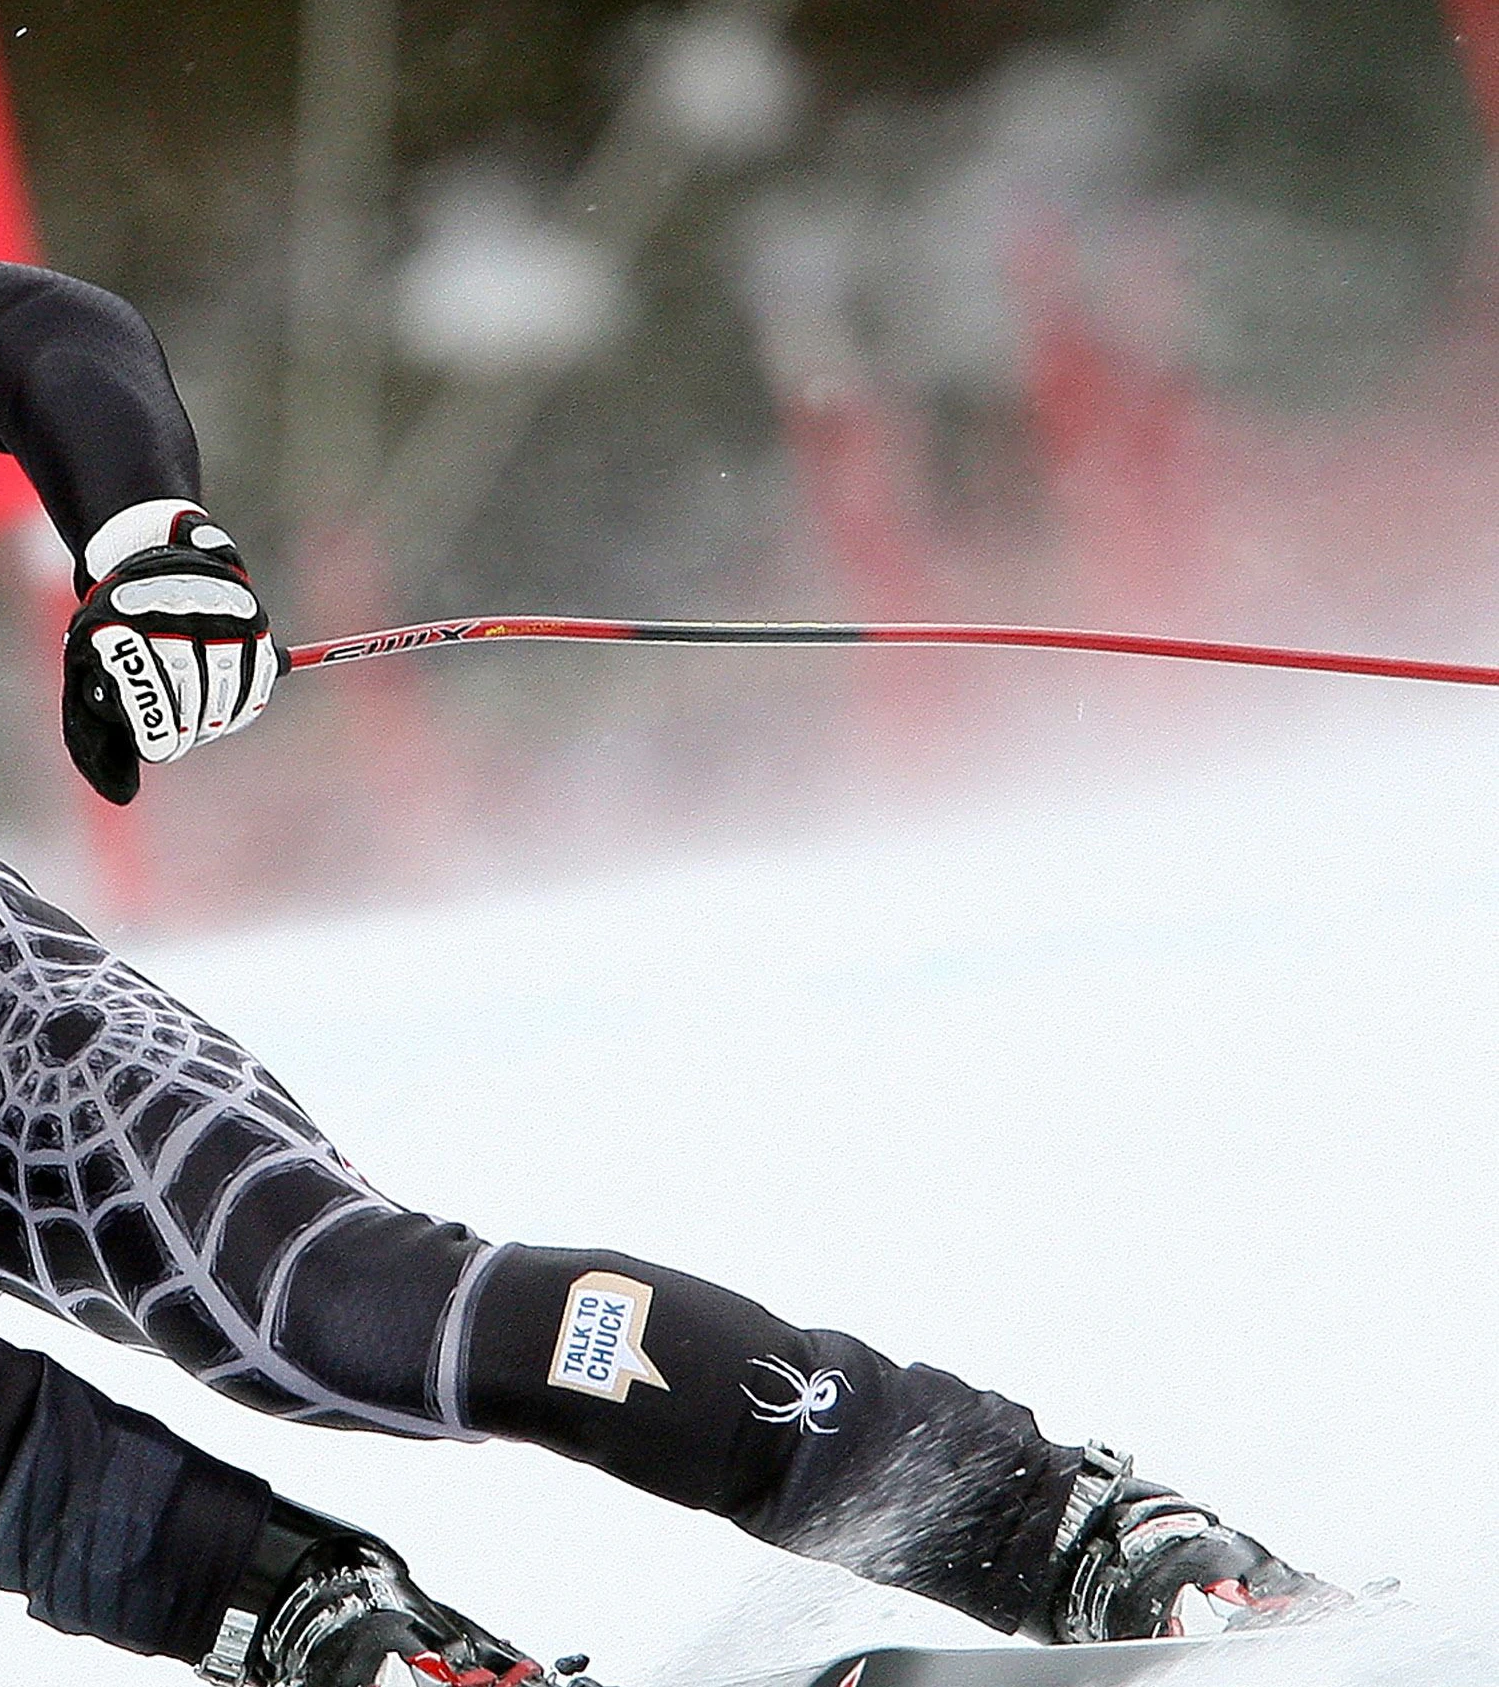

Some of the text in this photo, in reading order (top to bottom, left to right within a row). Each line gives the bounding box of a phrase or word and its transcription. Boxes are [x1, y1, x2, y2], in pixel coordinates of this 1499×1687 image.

[108, 637, 169, 742] reusch
[563, 1297, 599, 1375] TALK TO
[587, 1300, 626, 1382] CHUCK
